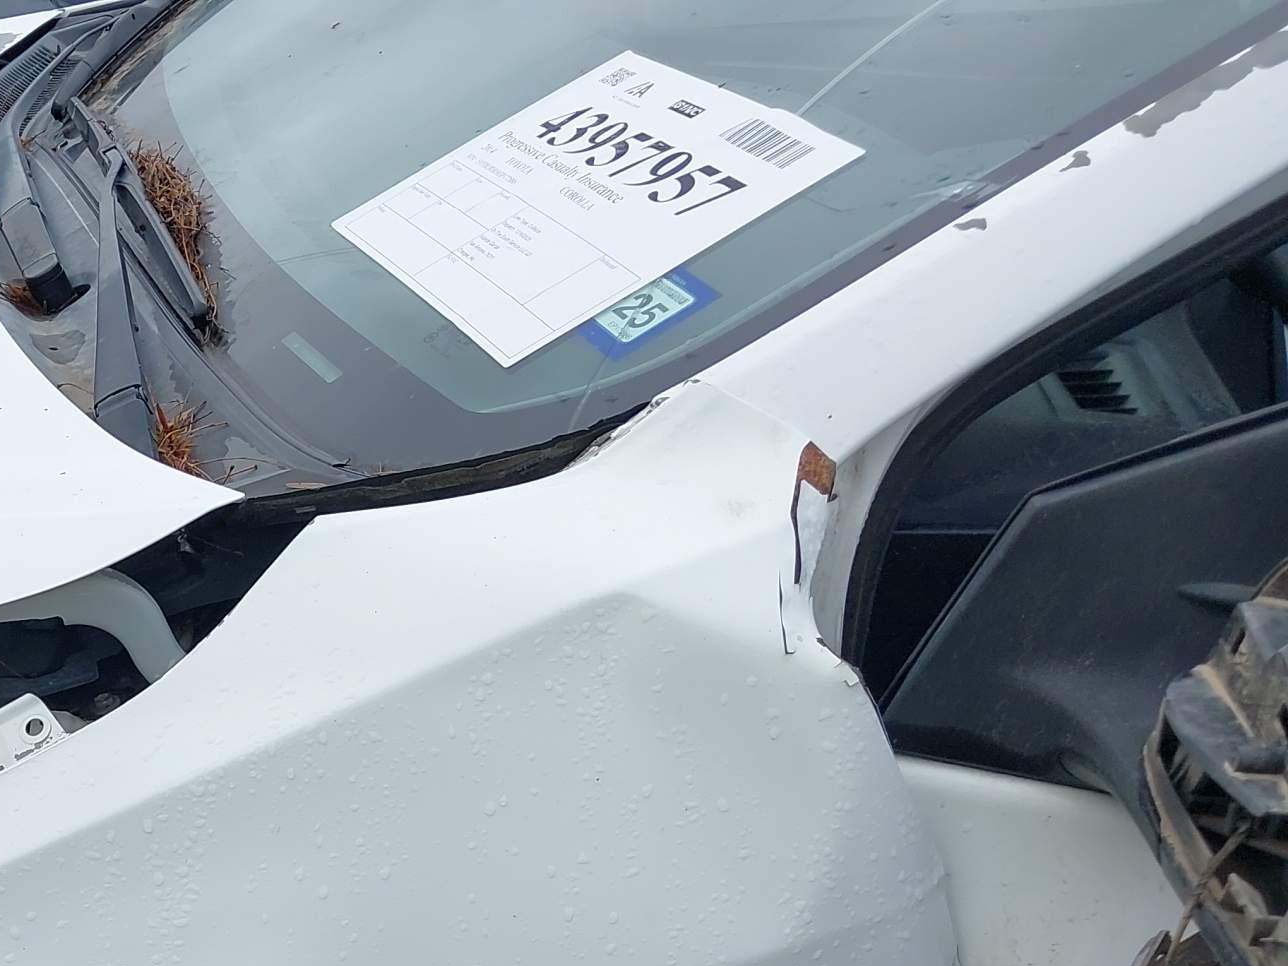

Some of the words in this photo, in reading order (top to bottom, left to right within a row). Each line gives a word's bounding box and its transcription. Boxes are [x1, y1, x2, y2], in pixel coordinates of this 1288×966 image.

[498, 131, 546, 163] Progressive
[541, 154, 581, 181] Casualty
[576, 172, 625, 204] Insurance
[537, 106, 747, 216] 43957957
[559, 186, 596, 211] COROLLA
[612, 293, 669, 329] 25
